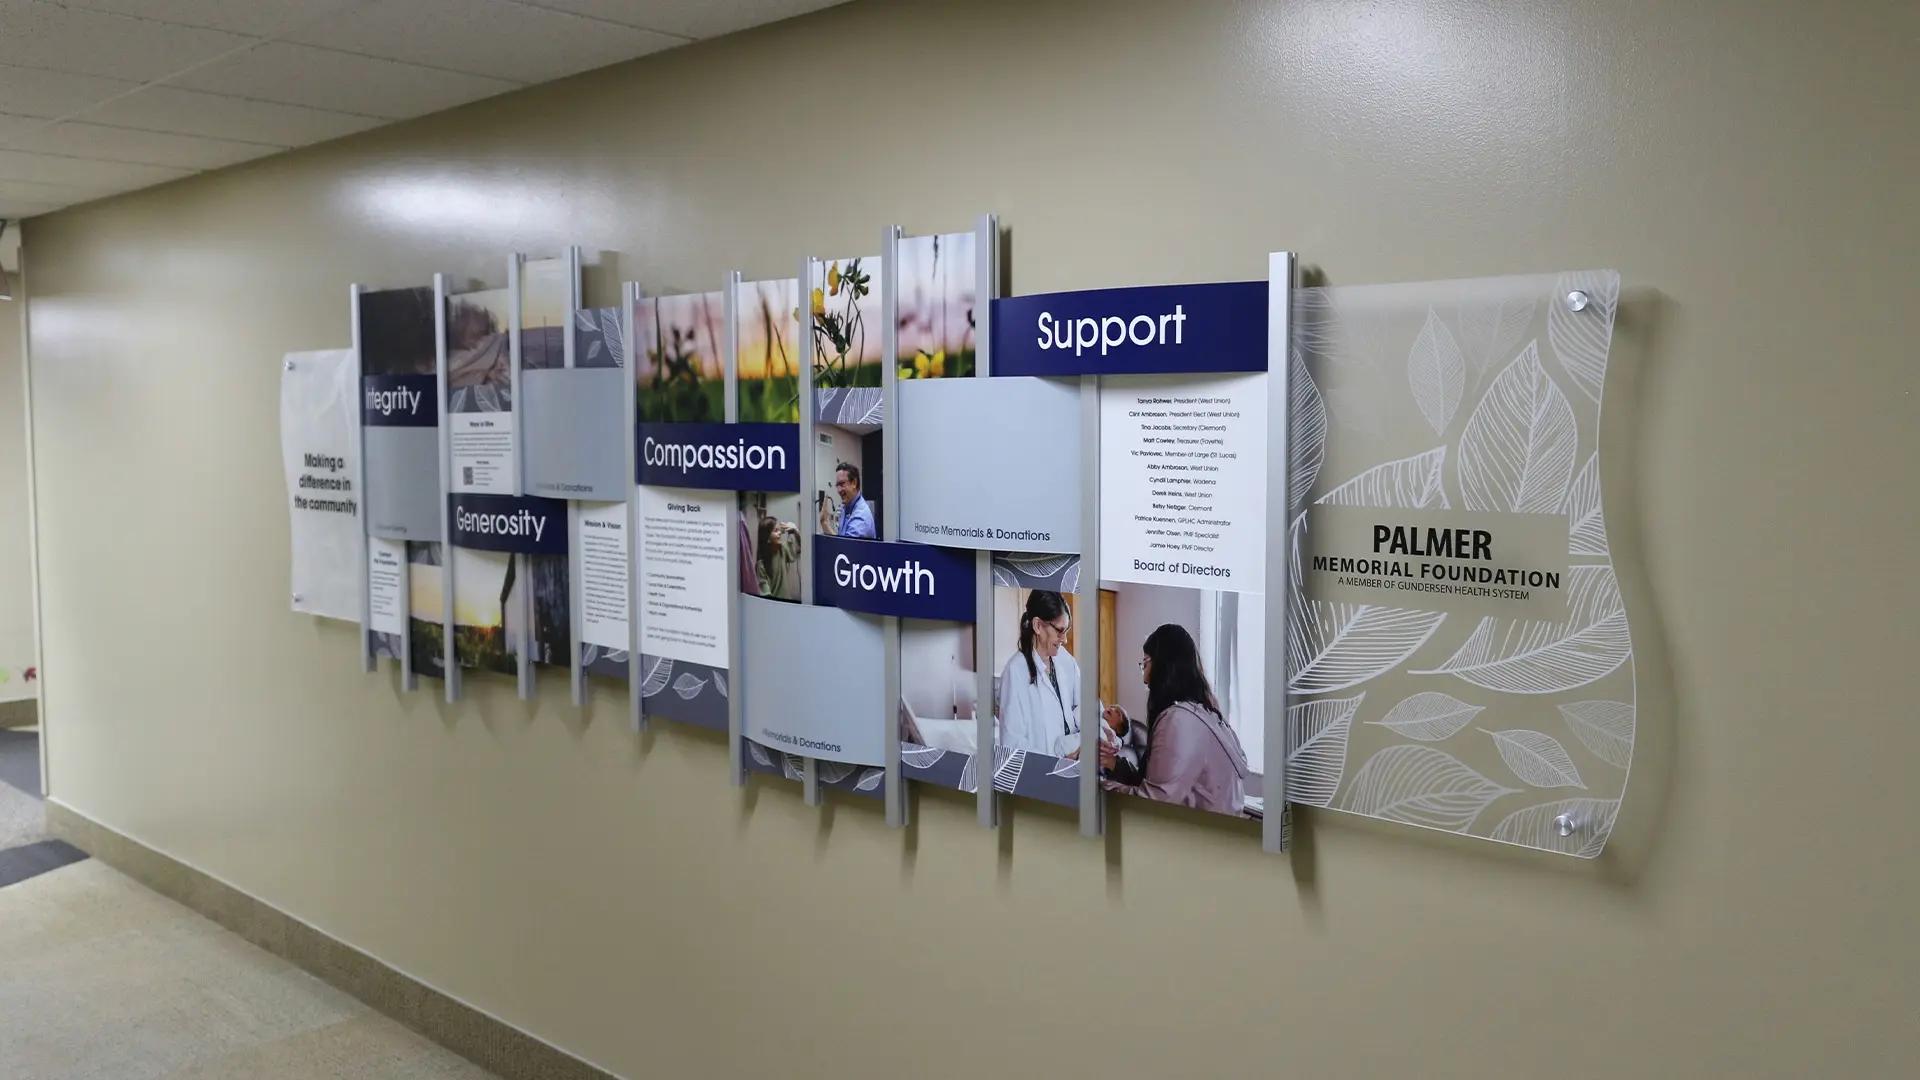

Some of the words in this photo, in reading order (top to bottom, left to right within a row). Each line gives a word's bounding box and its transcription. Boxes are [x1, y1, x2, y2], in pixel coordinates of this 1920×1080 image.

[1037, 304, 1187, 357] Support
[365, 385, 421, 416] Integrity
[304, 453, 336, 472] Making
[337, 456, 344, 469] a
[644, 436, 786, 474] Compassion
[299, 474, 341, 491] difference
[342, 477, 351, 492] in
[561, 483, 593, 492] Donations
[294, 495, 307, 509] the
[308, 498, 357, 516] community
[667, 503, 686, 514] Giving
[686, 504, 701, 512] Back
[456, 505, 546, 542] Generosity
[914, 522, 940, 535] Hospice
[940, 524, 984, 539] Memorials
[986, 528, 994, 538] &
[996, 528, 1050, 541] Donations
[1373, 525, 1492, 560] PALMER
[834, 553, 935, 596] Growth
[1134, 559, 1165, 572] Board
[1168, 562, 1179, 573] of
[1182, 562, 1231, 578] Directors
[1313, 556, 1413, 578] MEMORIAL
[1420, 563, 1560, 589] FOUNDATION
[1338, 578, 1345, 586] A
[1346, 578, 1382, 589] MEMBER
[1384, 580, 1396, 590] OF
[1397, 581, 1452, 594] GUNDERSEN
[1454, 586, 1490, 597] HEALTH
[1492, 588, 1530, 600] SYSTEM
[799, 737, 841, 752] Donations
